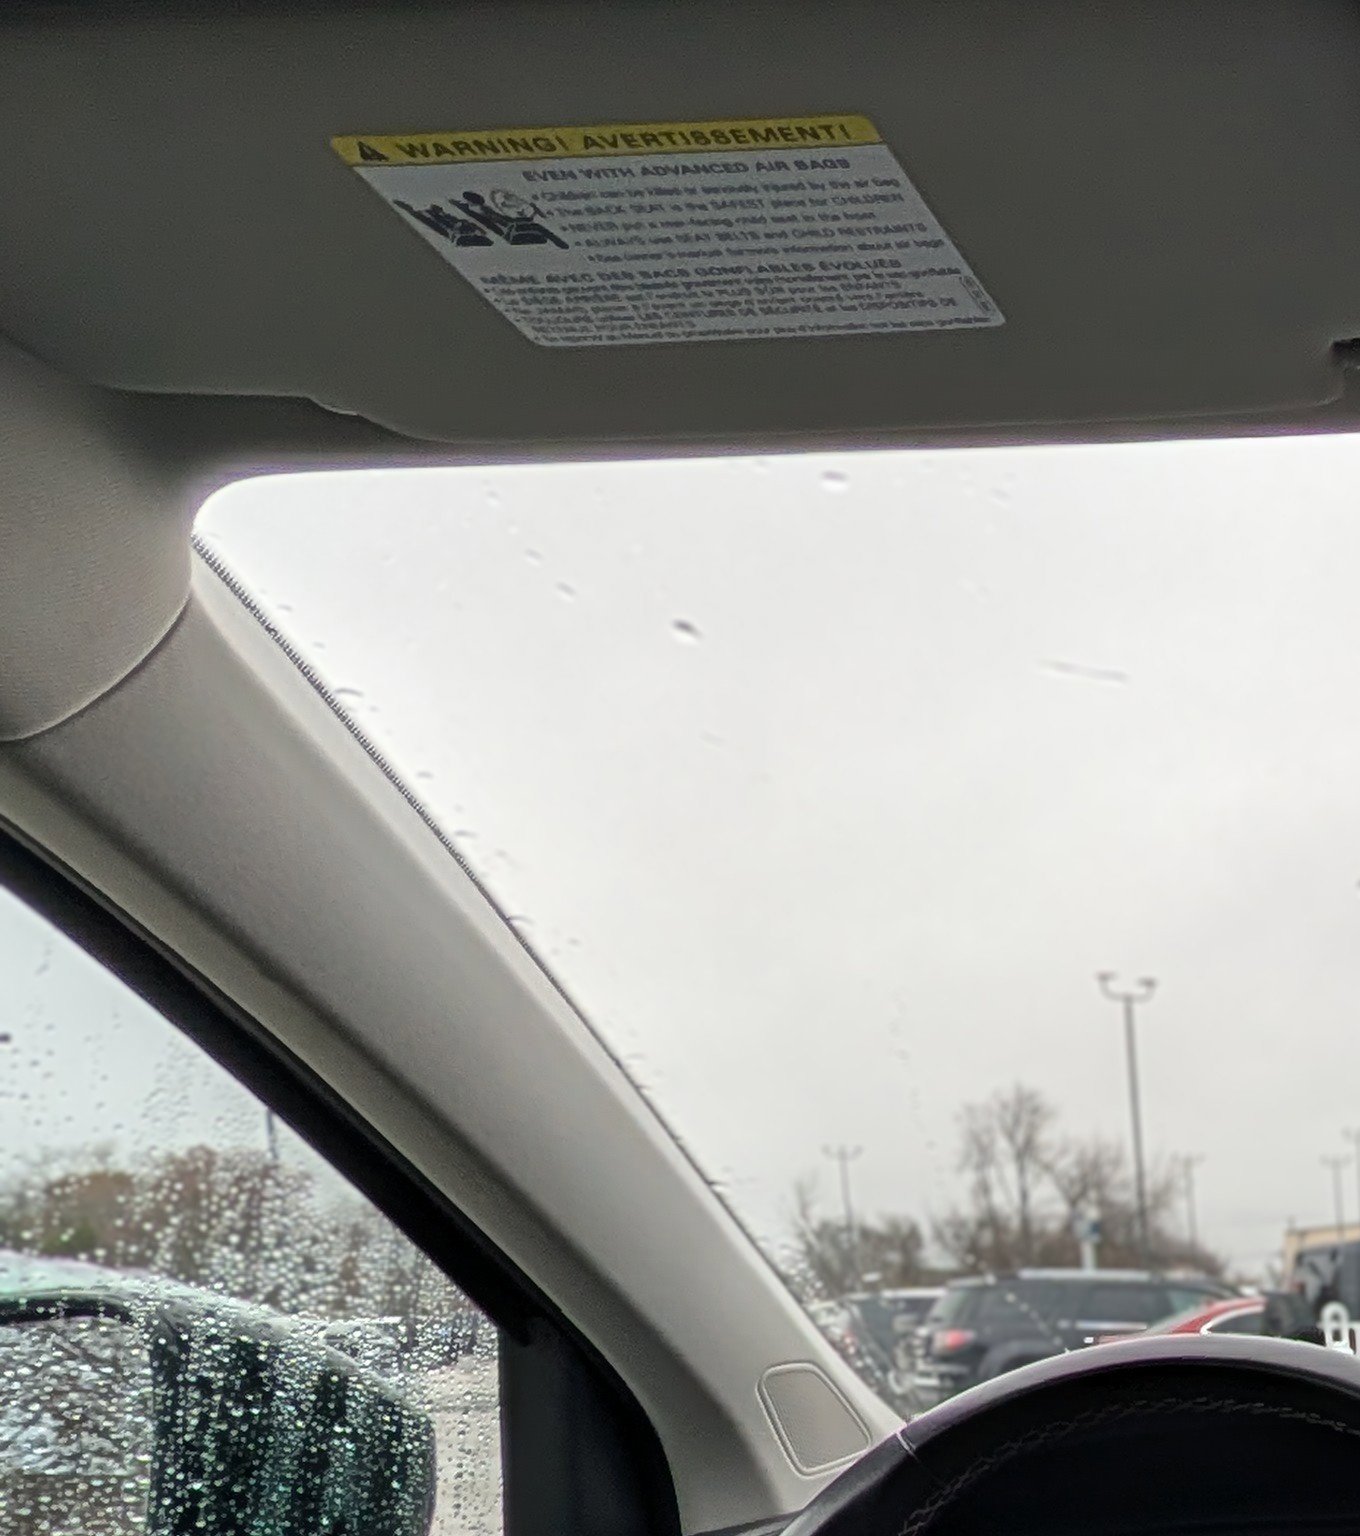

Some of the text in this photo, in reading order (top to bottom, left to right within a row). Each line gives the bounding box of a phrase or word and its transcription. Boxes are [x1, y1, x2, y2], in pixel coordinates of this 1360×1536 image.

[395, 123, 851, 158] WARNING! AVERTISSEMENT!
[522, 157, 851, 182] EVEN WITH ADVANCED AIR BAGS
